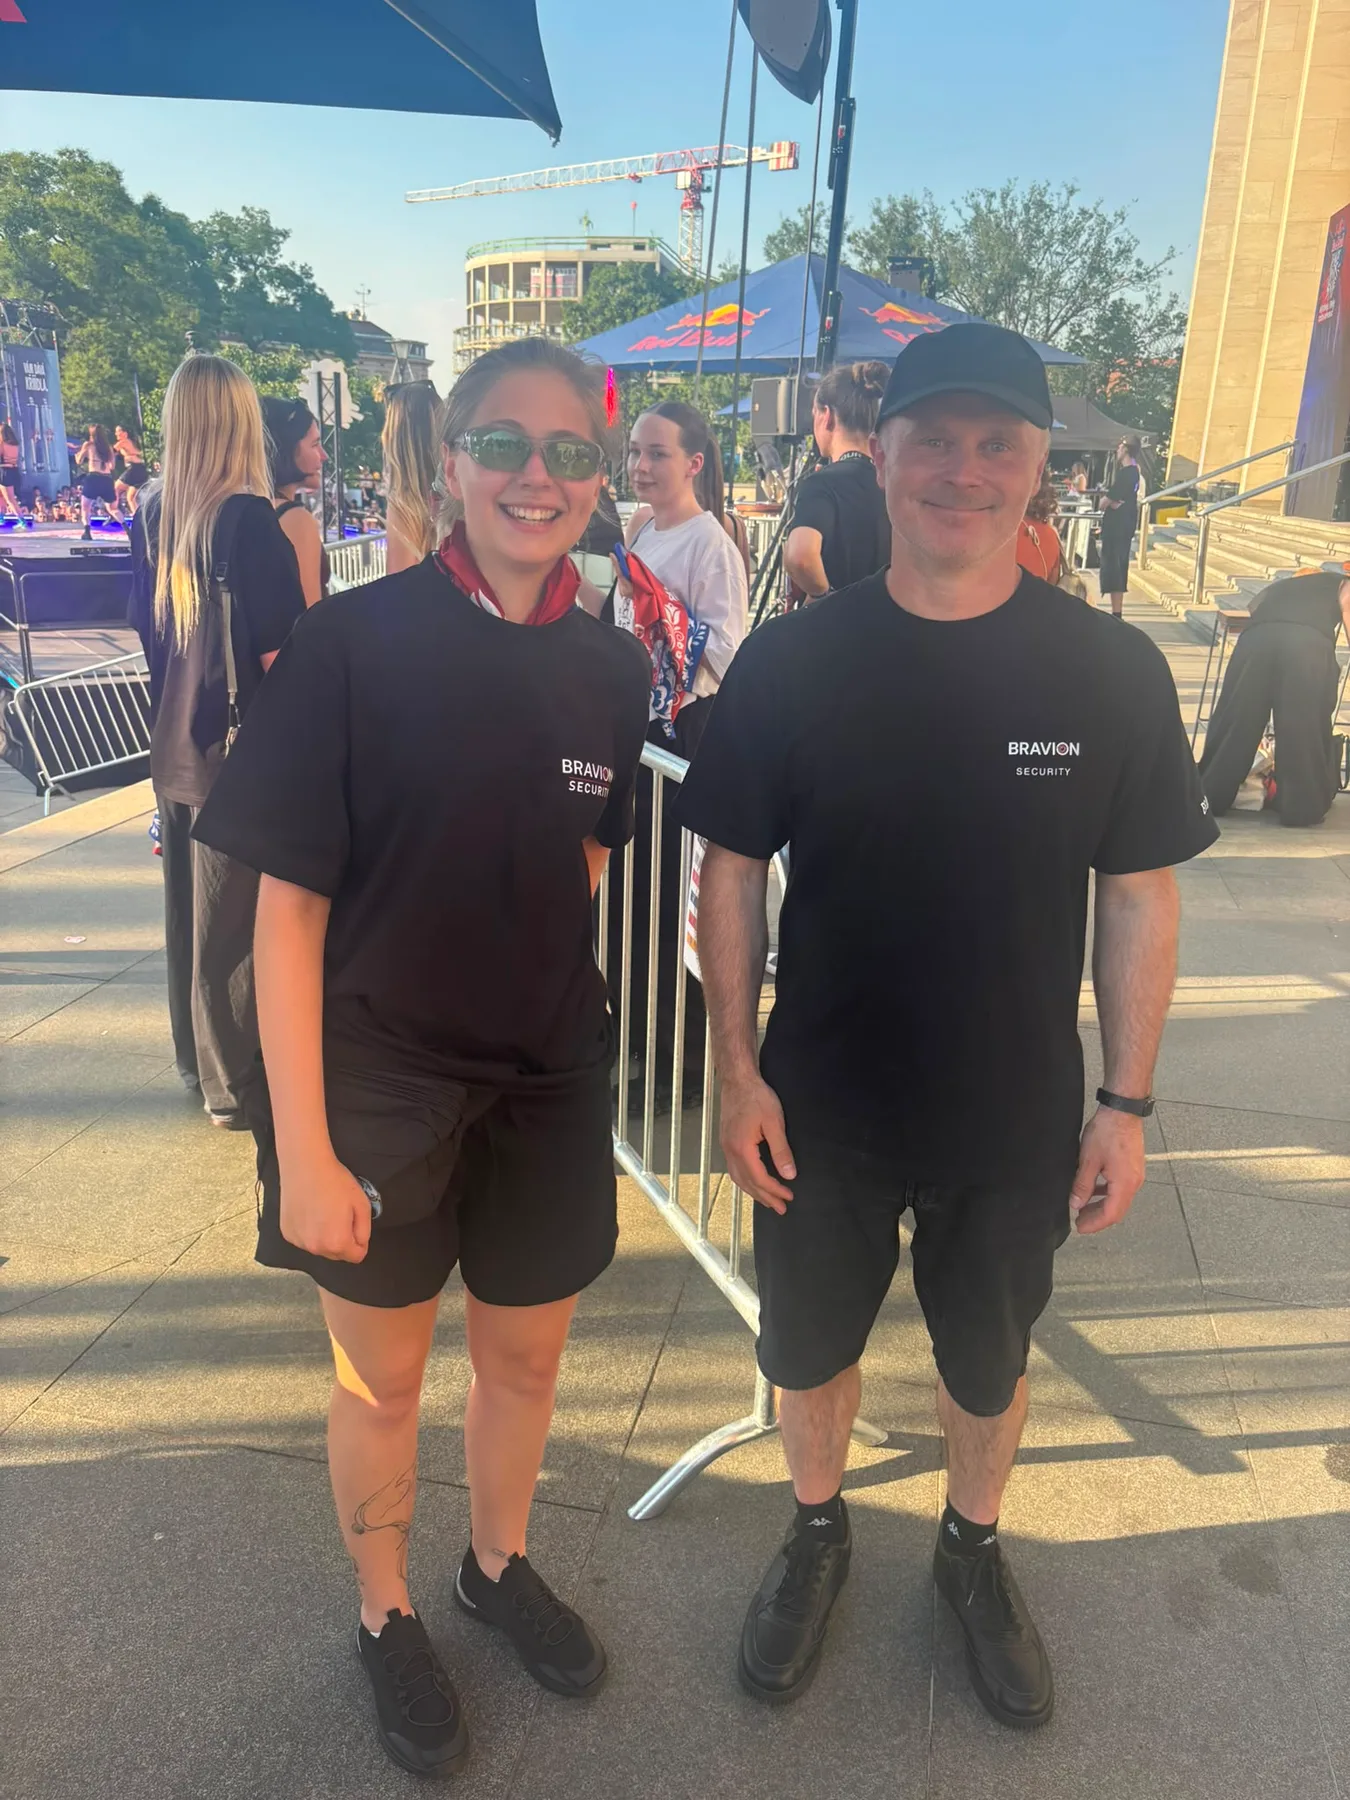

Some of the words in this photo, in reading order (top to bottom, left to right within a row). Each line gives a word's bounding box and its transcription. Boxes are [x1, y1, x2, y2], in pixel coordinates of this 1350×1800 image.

[627, 328, 694, 351] Red
[678, 329, 752, 347] Bull
[1008, 741, 1080, 756] BRAVION
[561, 758, 613, 783] BRAVION
[1016, 767, 1071, 776] SECURITY
